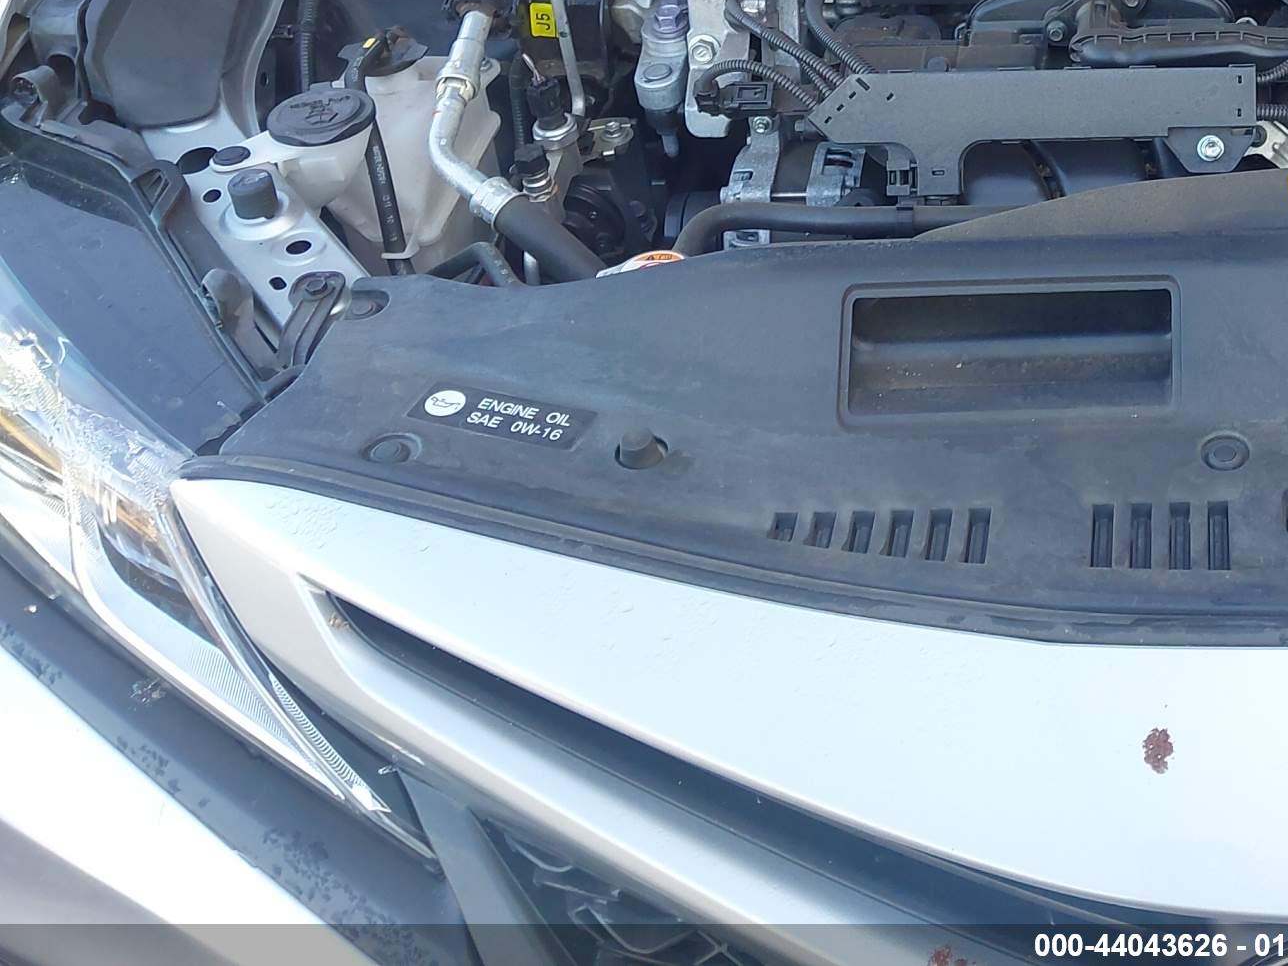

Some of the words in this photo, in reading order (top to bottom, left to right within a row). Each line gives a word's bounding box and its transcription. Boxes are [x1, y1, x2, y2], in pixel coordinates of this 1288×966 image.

[536, 12, 551, 31] J5
[466, 411, 504, 428] SAE
[509, 420, 563, 441] 0W-16
[477, 397, 540, 420] ENGINE
[545, 411, 572, 427] OIL
